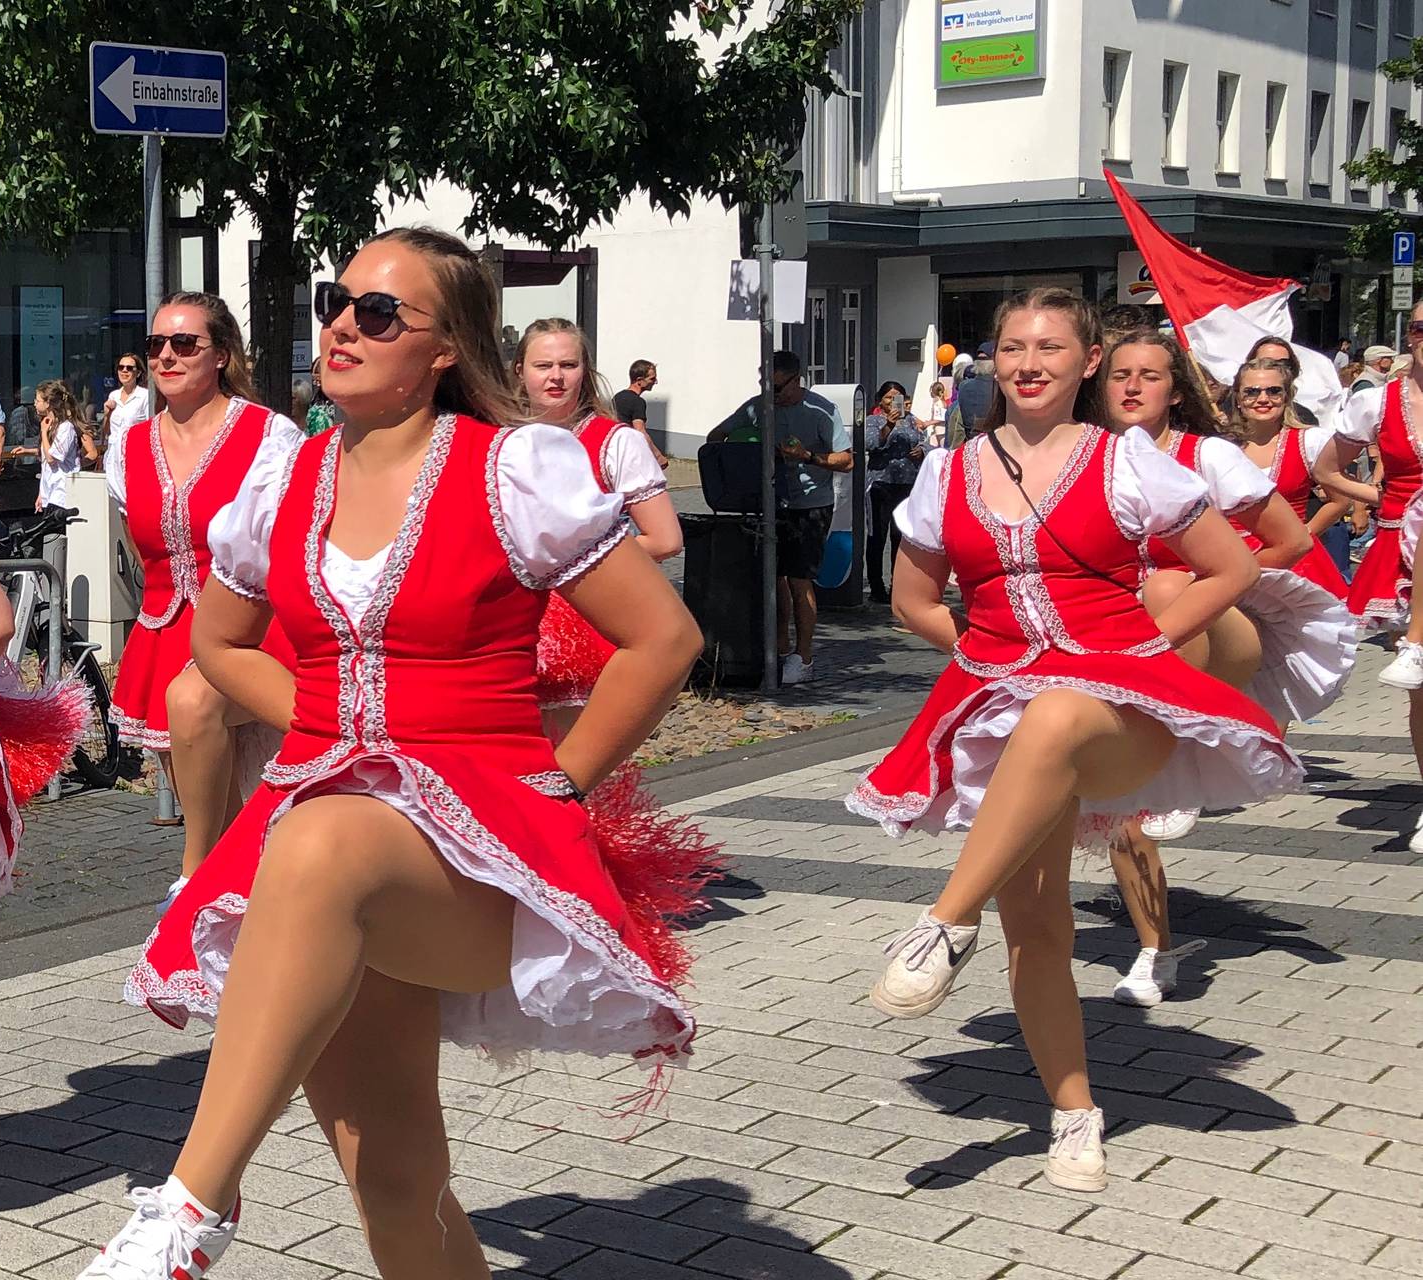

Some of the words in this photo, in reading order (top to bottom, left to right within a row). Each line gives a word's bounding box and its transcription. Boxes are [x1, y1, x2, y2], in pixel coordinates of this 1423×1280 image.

[966, 9, 1001, 20] Volksbank
[976, 16, 1014, 26] Bergischen
[1015, 13, 1034, 21] Land
[132, 80, 219, 104] Einbahnstraße
[1398, 236, 1410, 260] P
